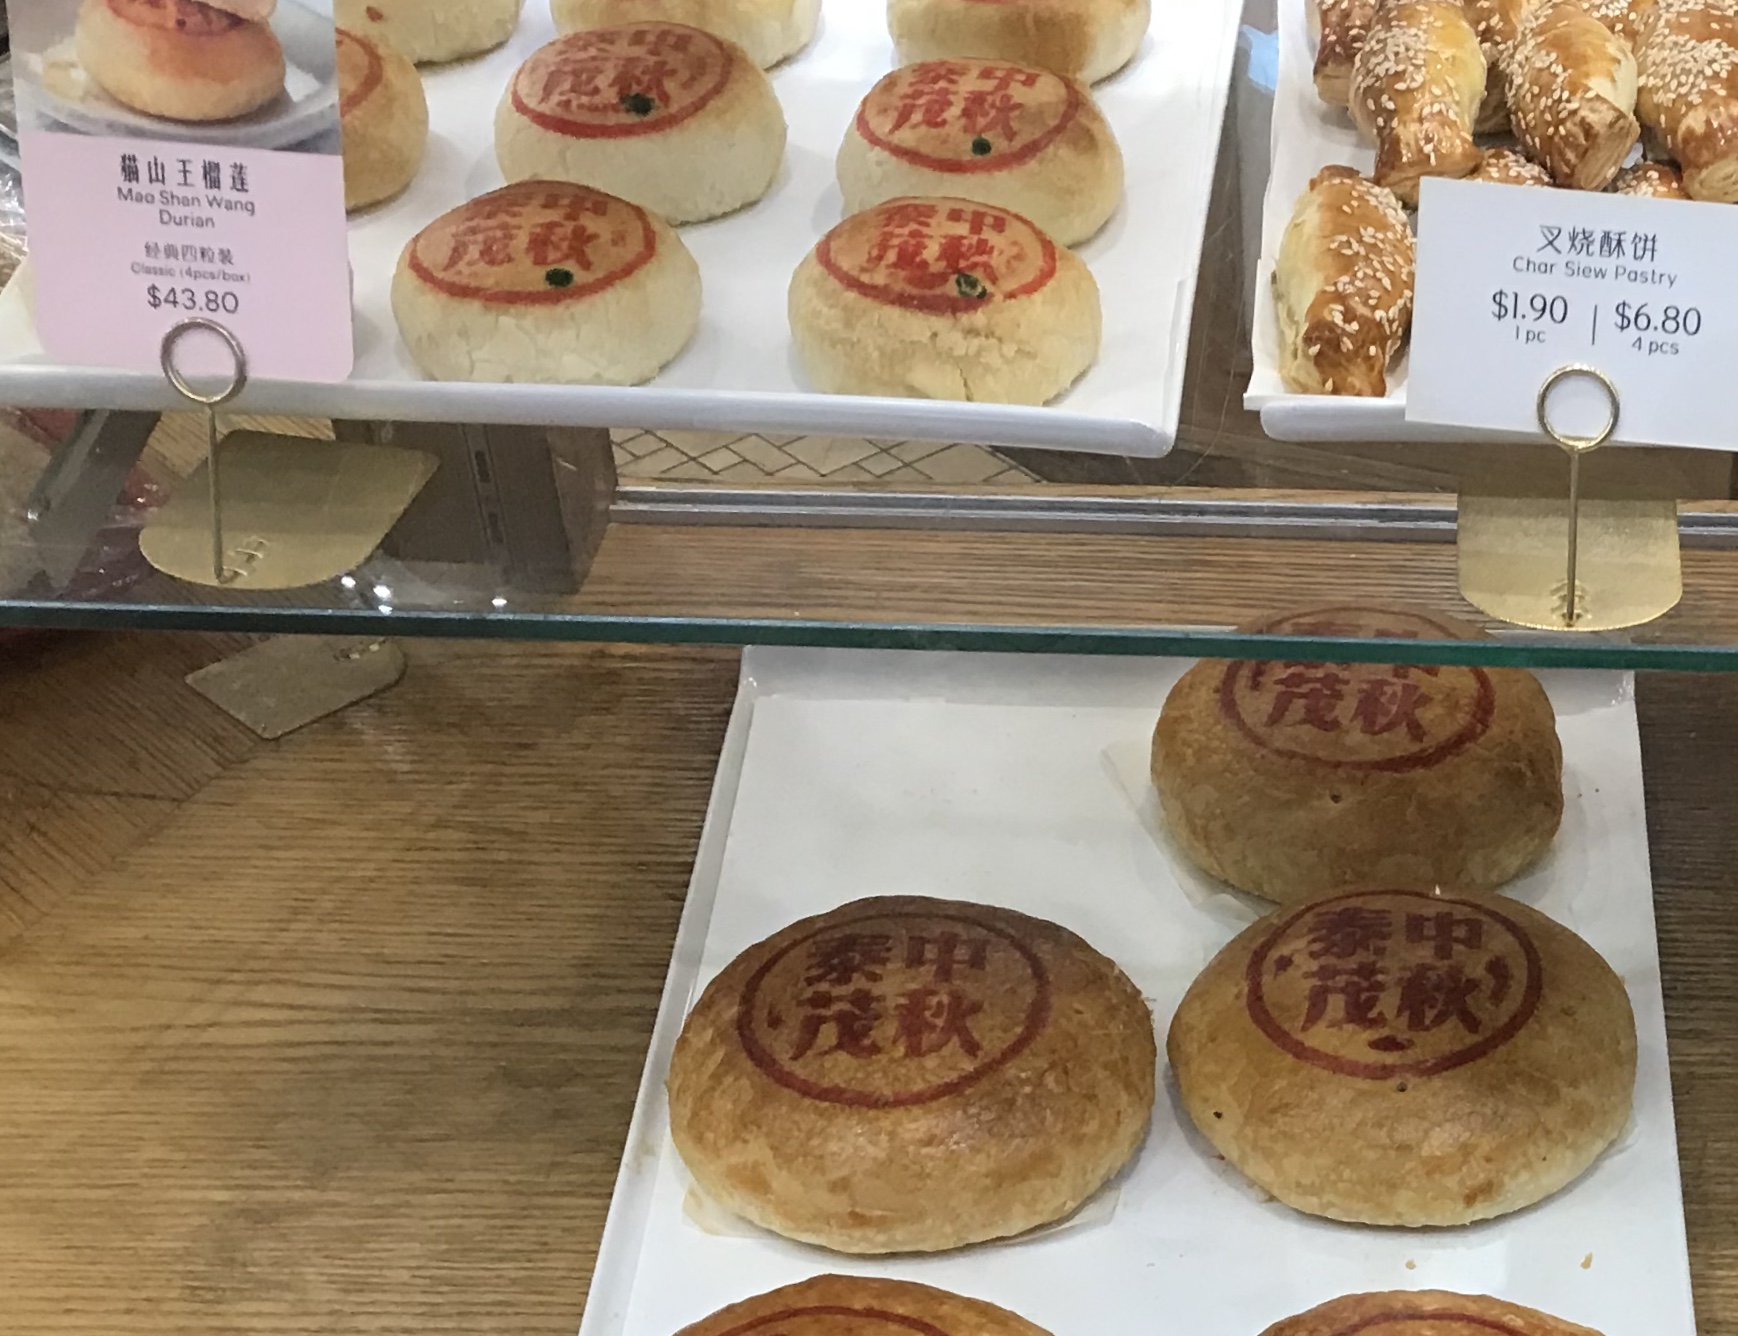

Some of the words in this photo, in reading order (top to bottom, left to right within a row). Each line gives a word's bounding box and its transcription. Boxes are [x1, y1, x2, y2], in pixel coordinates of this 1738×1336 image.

[117, 186, 155, 204] Mao
[159, 190, 201, 207] Shan
[205, 194, 255, 216] Wang
[159, 209, 215, 228] Durian
[1536, 224, 1658, 262] 叉烧酥饼
[131, 261, 176, 277] Classic
[1512, 255, 1556, 275] Char
[1565, 260, 1607, 279] Siew
[1615, 265, 1677, 289] Pastry
[147, 284, 239, 314] $43.80
[1492, 289, 1569, 324] $1.90
[1614, 300, 1702, 336] $6.80
